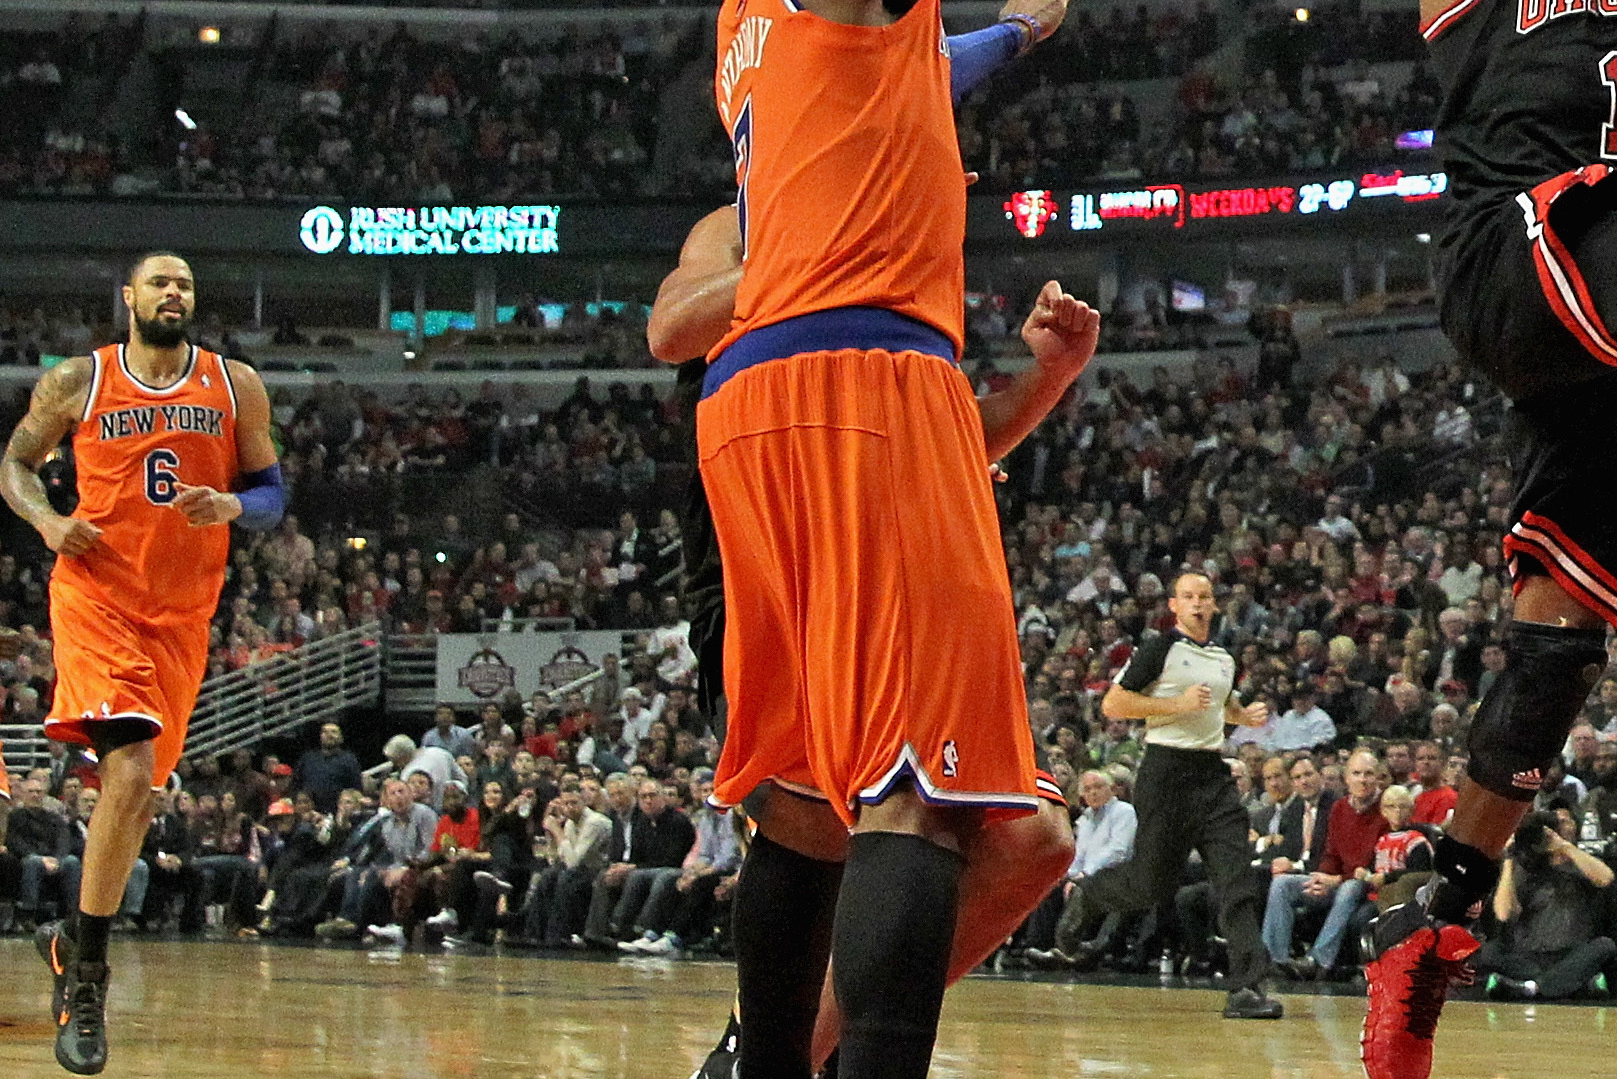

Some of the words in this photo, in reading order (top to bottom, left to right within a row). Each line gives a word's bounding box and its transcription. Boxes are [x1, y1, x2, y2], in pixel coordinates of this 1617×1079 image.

[420, 206, 560, 231] UNIVERSITY
[348, 228, 459, 254] MEDICAL
[461, 228, 559, 254] CENTER
[99, 409, 156, 441] NEW
[159, 405, 225, 436] YORK
[144, 448, 180, 506] 6
